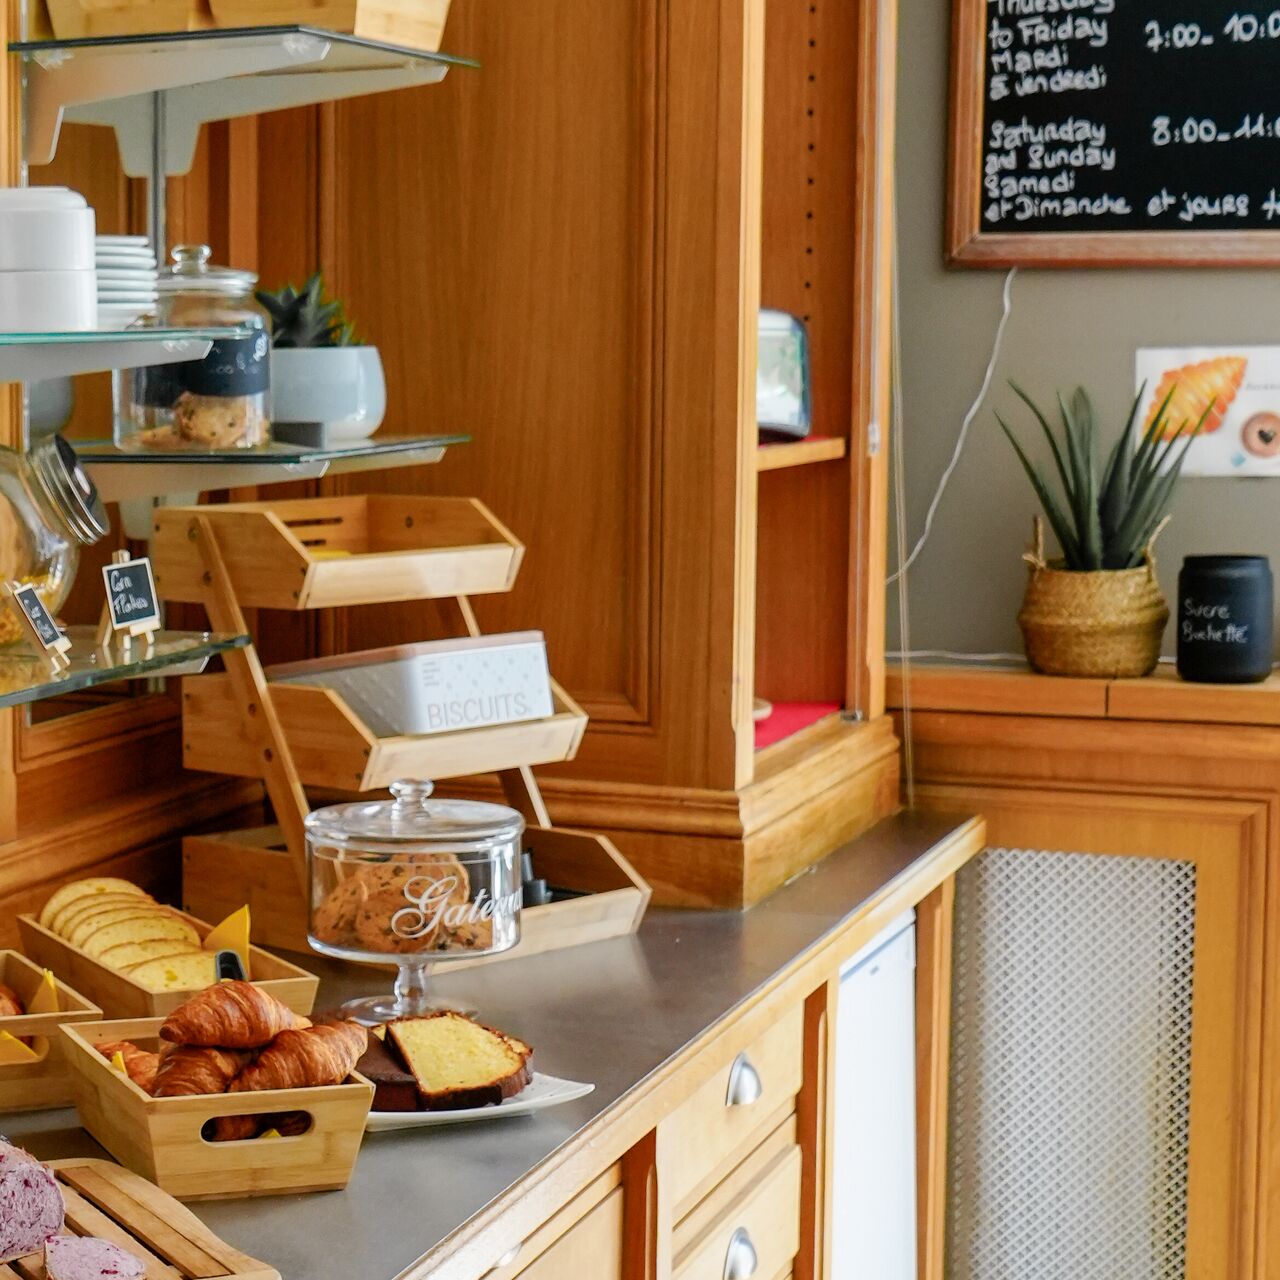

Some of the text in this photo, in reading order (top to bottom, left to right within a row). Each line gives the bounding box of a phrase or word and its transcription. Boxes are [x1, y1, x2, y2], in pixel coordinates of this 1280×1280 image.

[988, 17, 1014, 50] to
[1017, 12, 1108, 48] Friday
[989, 114, 1106, 150] Saturday
[1028, 141, 1117, 171] Sunday
[984, 169, 1076, 199] Samedi
[1147, 186, 1177, 217] et
[426, 691, 529, 729] BISCUITS
